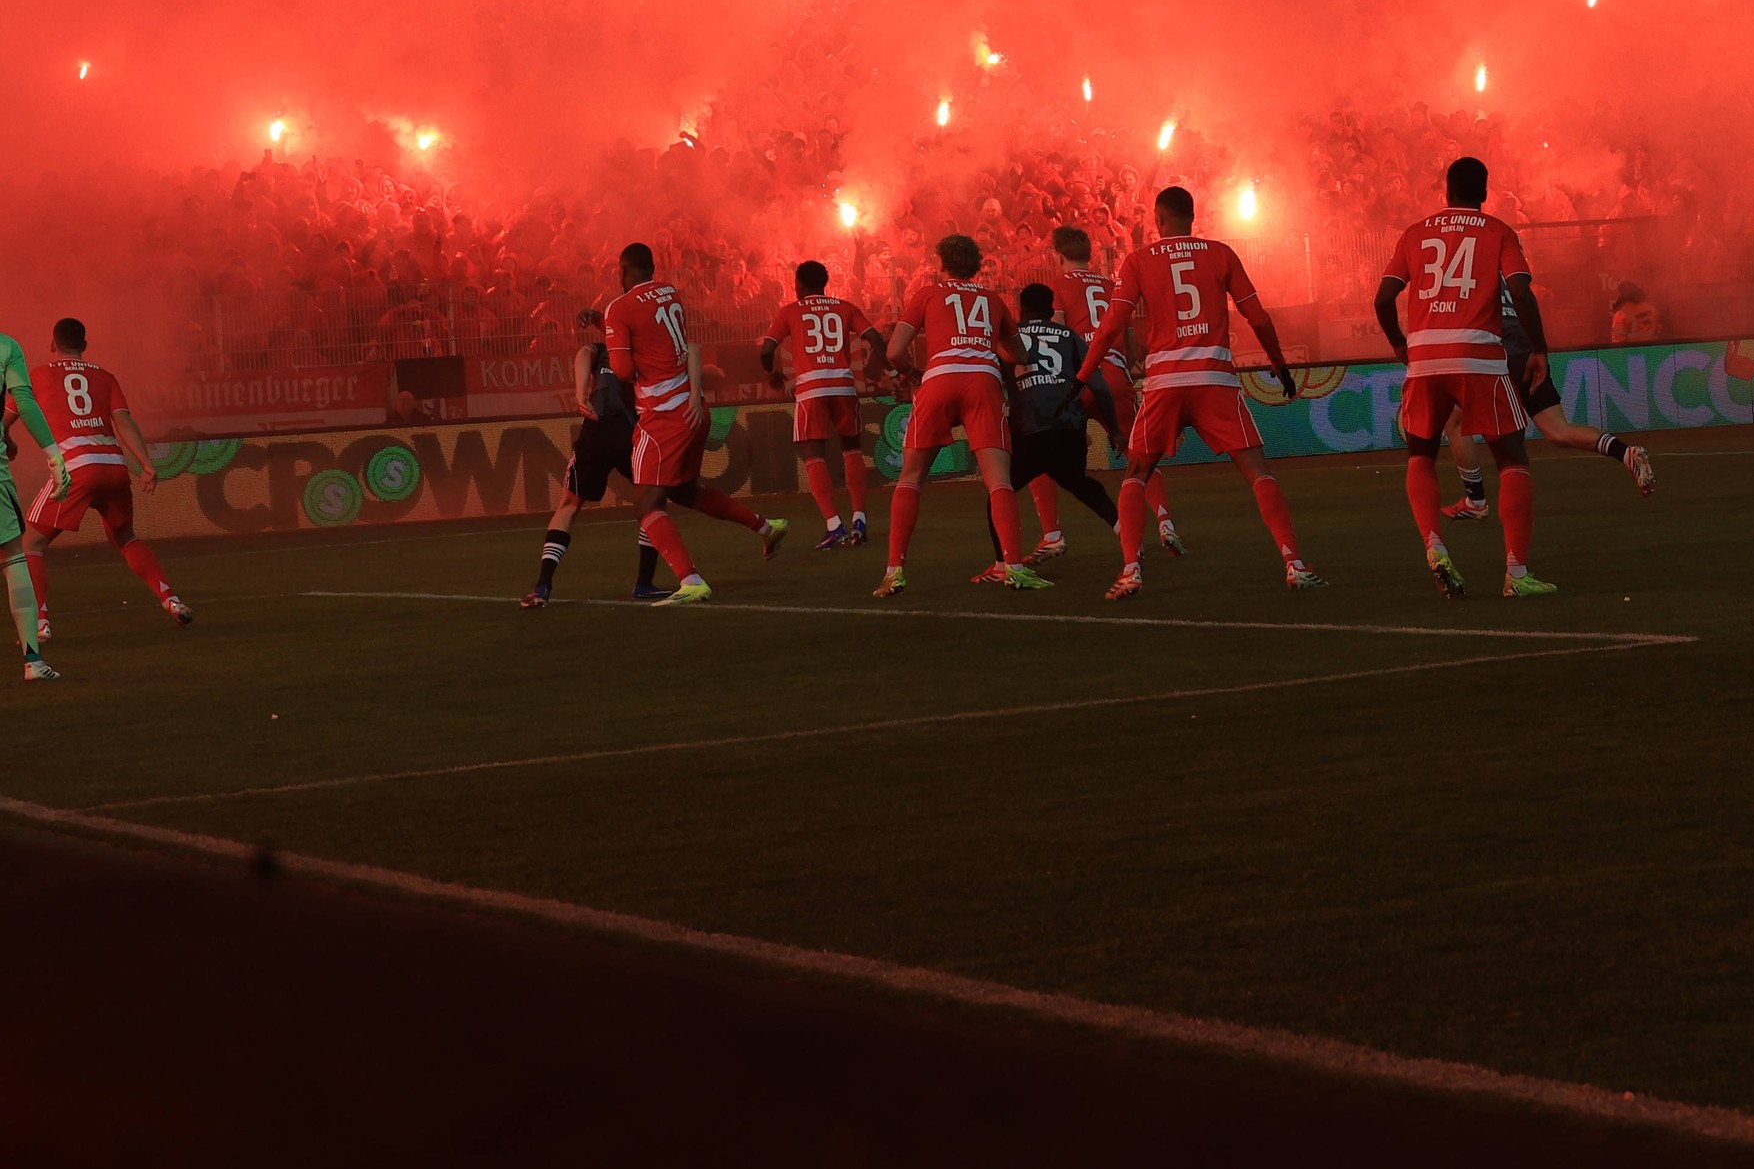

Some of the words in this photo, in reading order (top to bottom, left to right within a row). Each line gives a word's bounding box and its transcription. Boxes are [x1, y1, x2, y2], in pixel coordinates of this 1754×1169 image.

[1450, 215, 1486, 227] UNION
[1175, 242, 1208, 251] UNION
[1419, 236, 1477, 300] 34
[1170, 260, 1201, 321] 5
[655, 302, 688, 356] 10
[802, 312, 844, 354] 39
[945, 293, 993, 337] 14
[1176, 322, 1209, 338] DOEKHI
[950, 336, 992, 348] QUERFELD
[63, 372, 94, 417] 8
